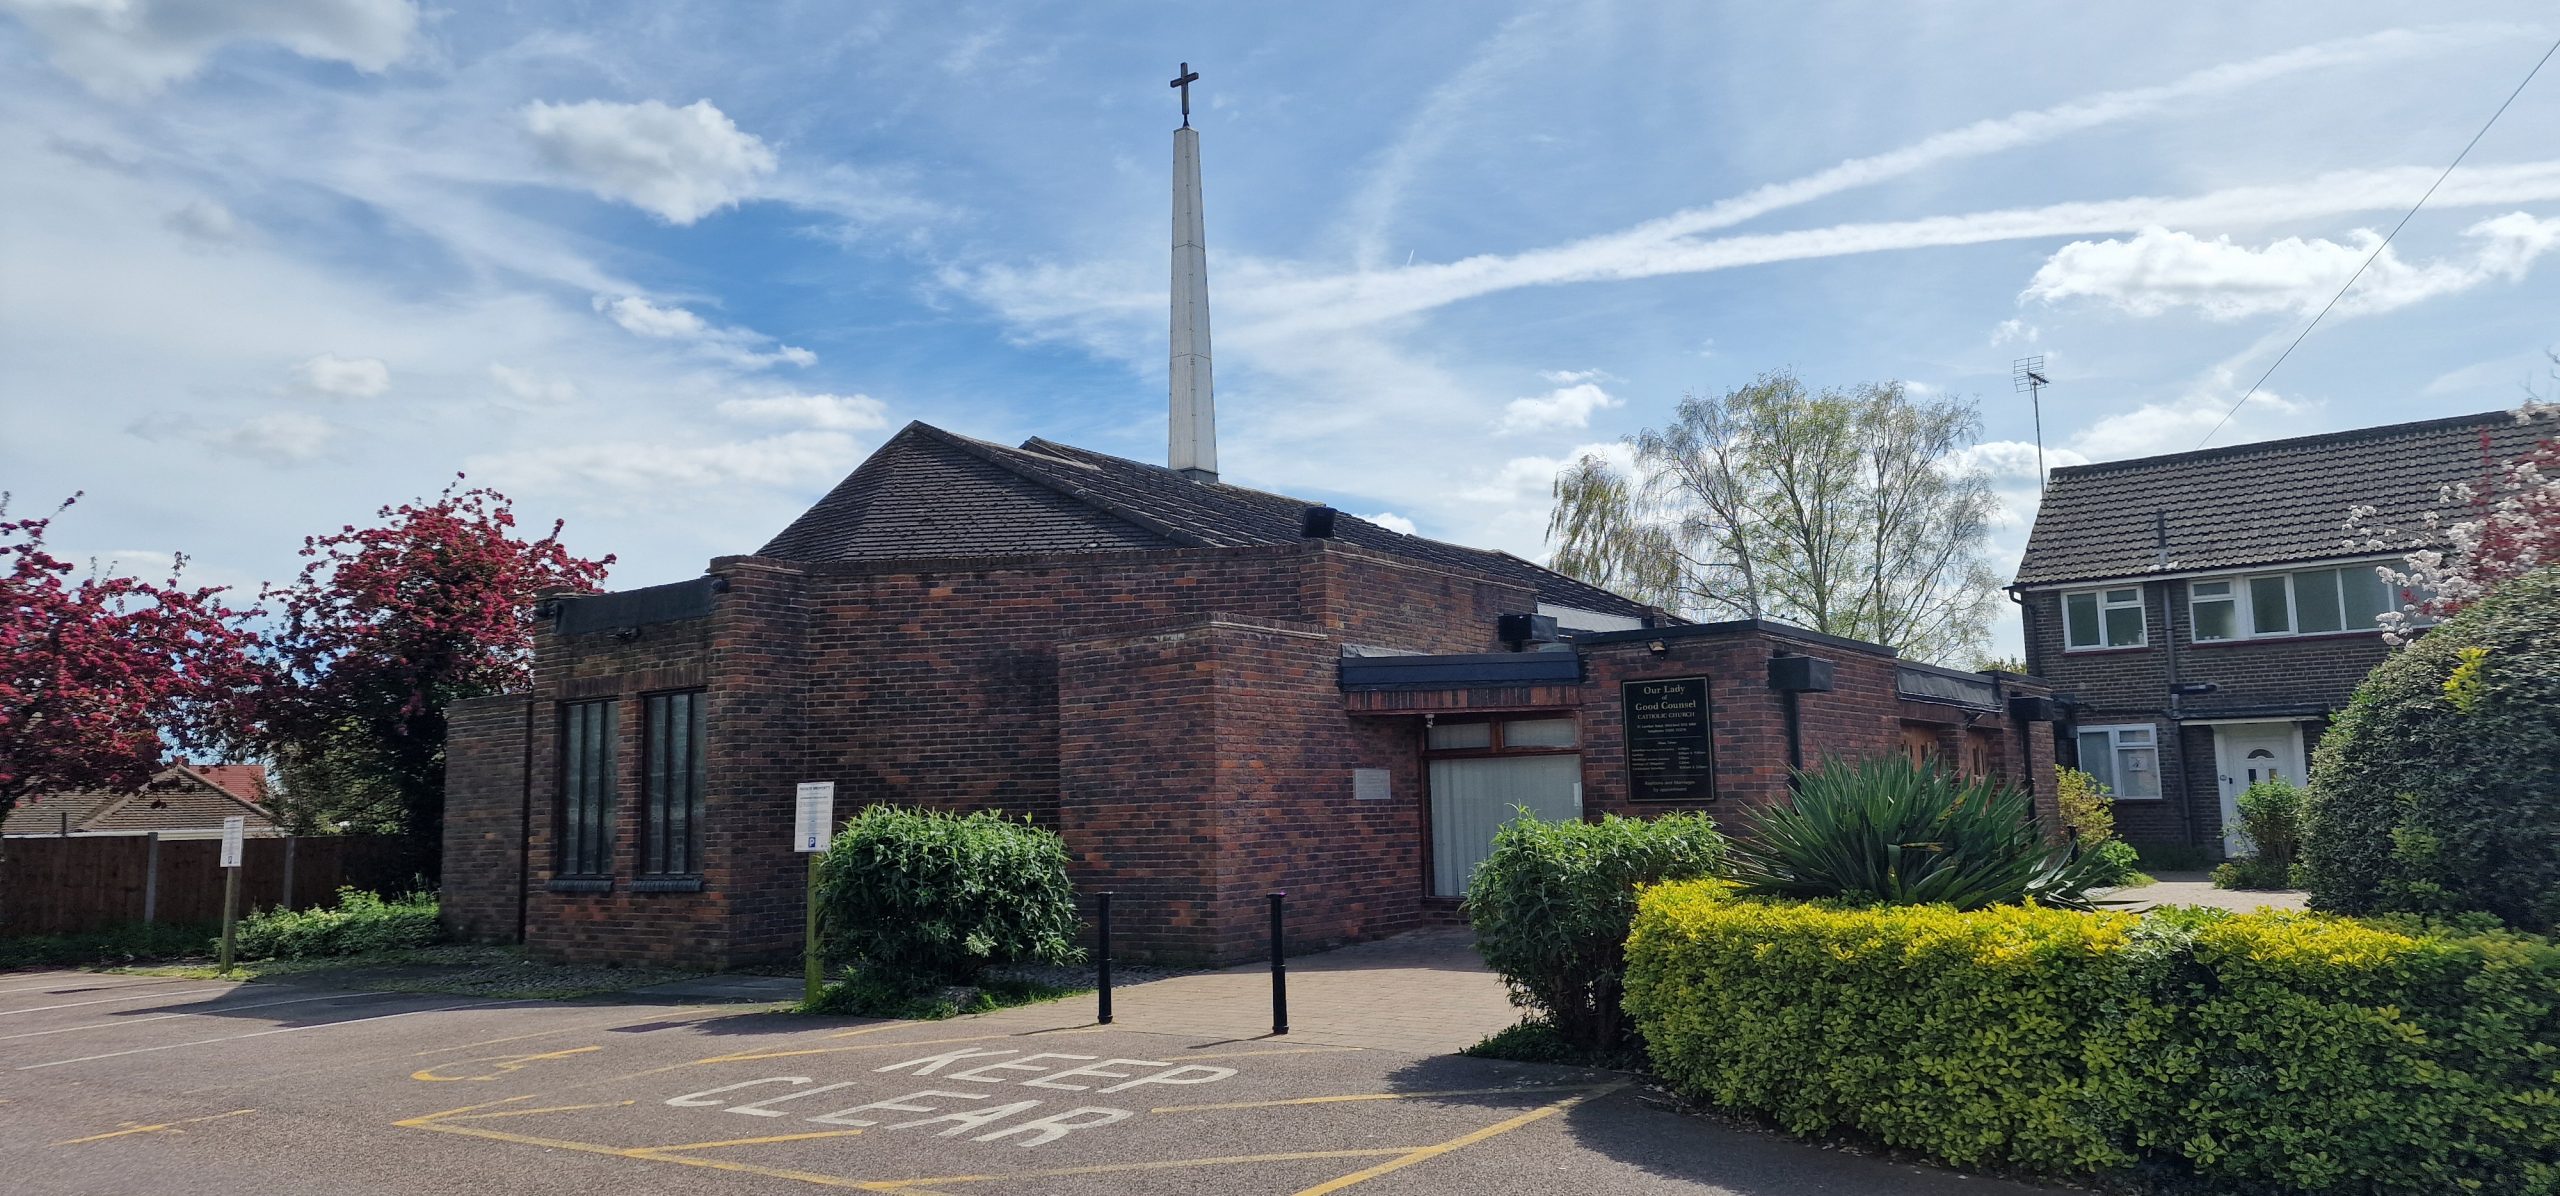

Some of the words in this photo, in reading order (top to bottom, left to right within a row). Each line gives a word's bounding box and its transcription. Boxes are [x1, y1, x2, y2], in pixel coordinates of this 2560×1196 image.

[1643, 686, 1661, 694] Our
[1664, 684, 1685, 695] Lady
[1635, 702, 1659, 711] Good
[1661, 700, 1696, 710] Counsel
[873, 1047, 1238, 1094] KEEP
[664, 1076, 1135, 1148] CLEAR
